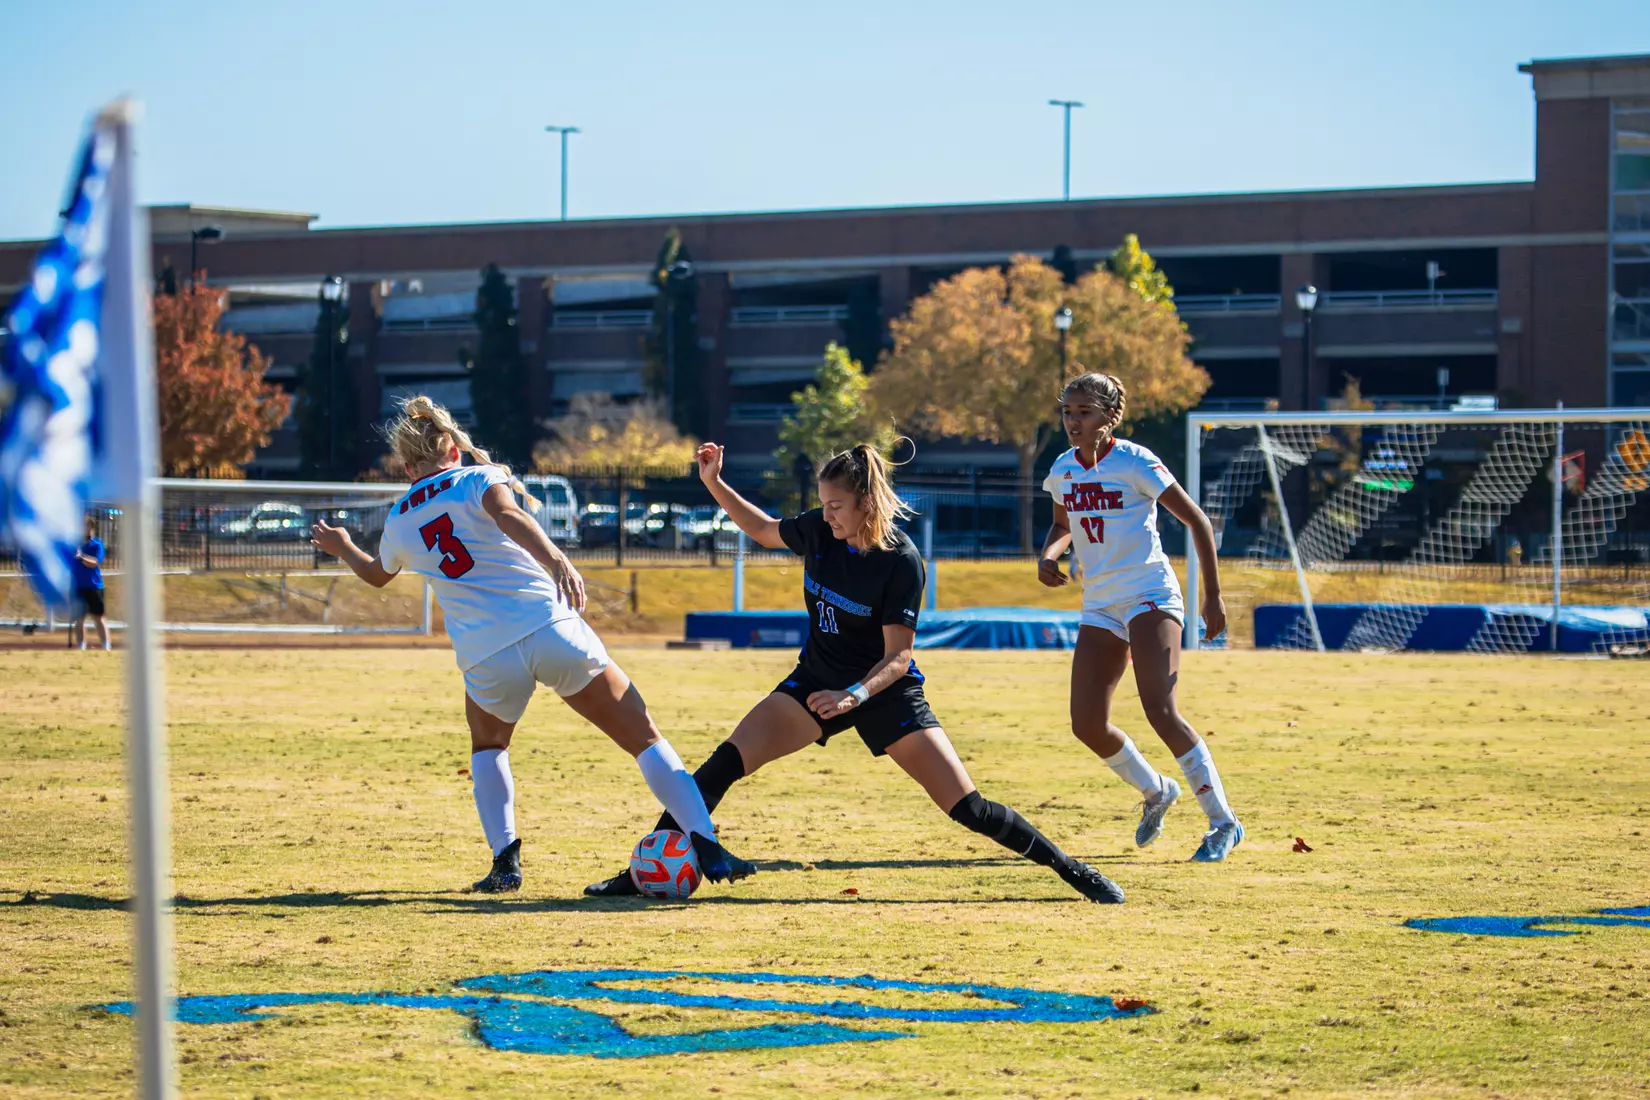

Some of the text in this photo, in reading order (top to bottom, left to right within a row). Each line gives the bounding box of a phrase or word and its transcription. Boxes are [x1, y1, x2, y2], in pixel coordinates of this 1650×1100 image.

[419, 512, 475, 579] 3
[1080, 515, 1105, 544] 17
[816, 601, 839, 634] 11
